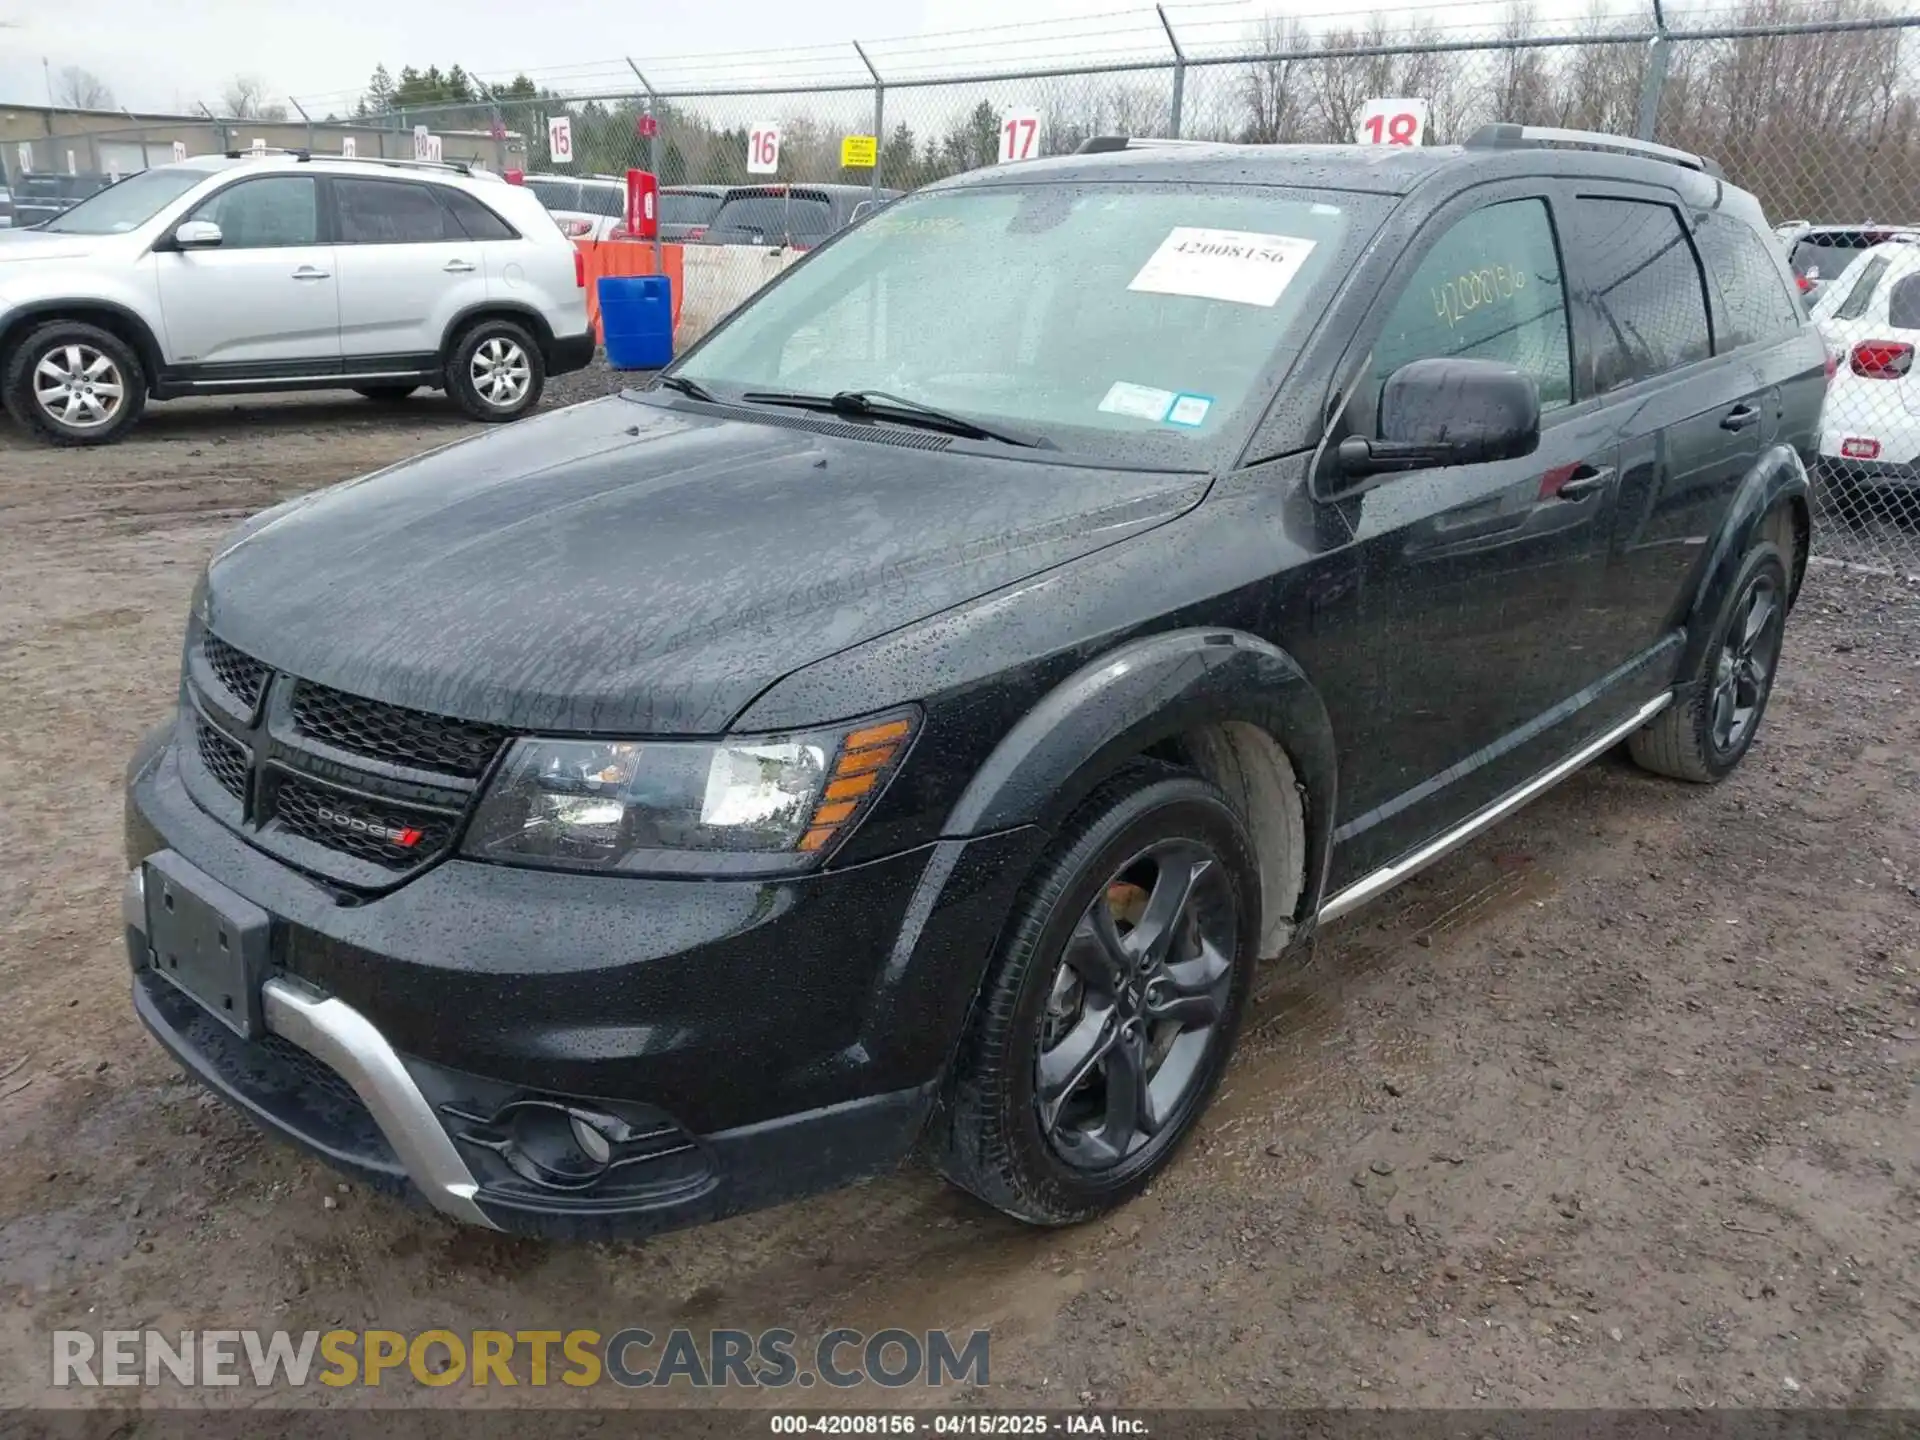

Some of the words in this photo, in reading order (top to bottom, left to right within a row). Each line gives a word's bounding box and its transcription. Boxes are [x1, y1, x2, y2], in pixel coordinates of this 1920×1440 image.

[552, 125, 569, 154] 15
[1005, 119, 1036, 160] 17
[1365, 113, 1417, 145] 18
[752, 131, 776, 164] 16
[1174, 241, 1284, 263] 42008156
[318, 807, 405, 842] DODGE
